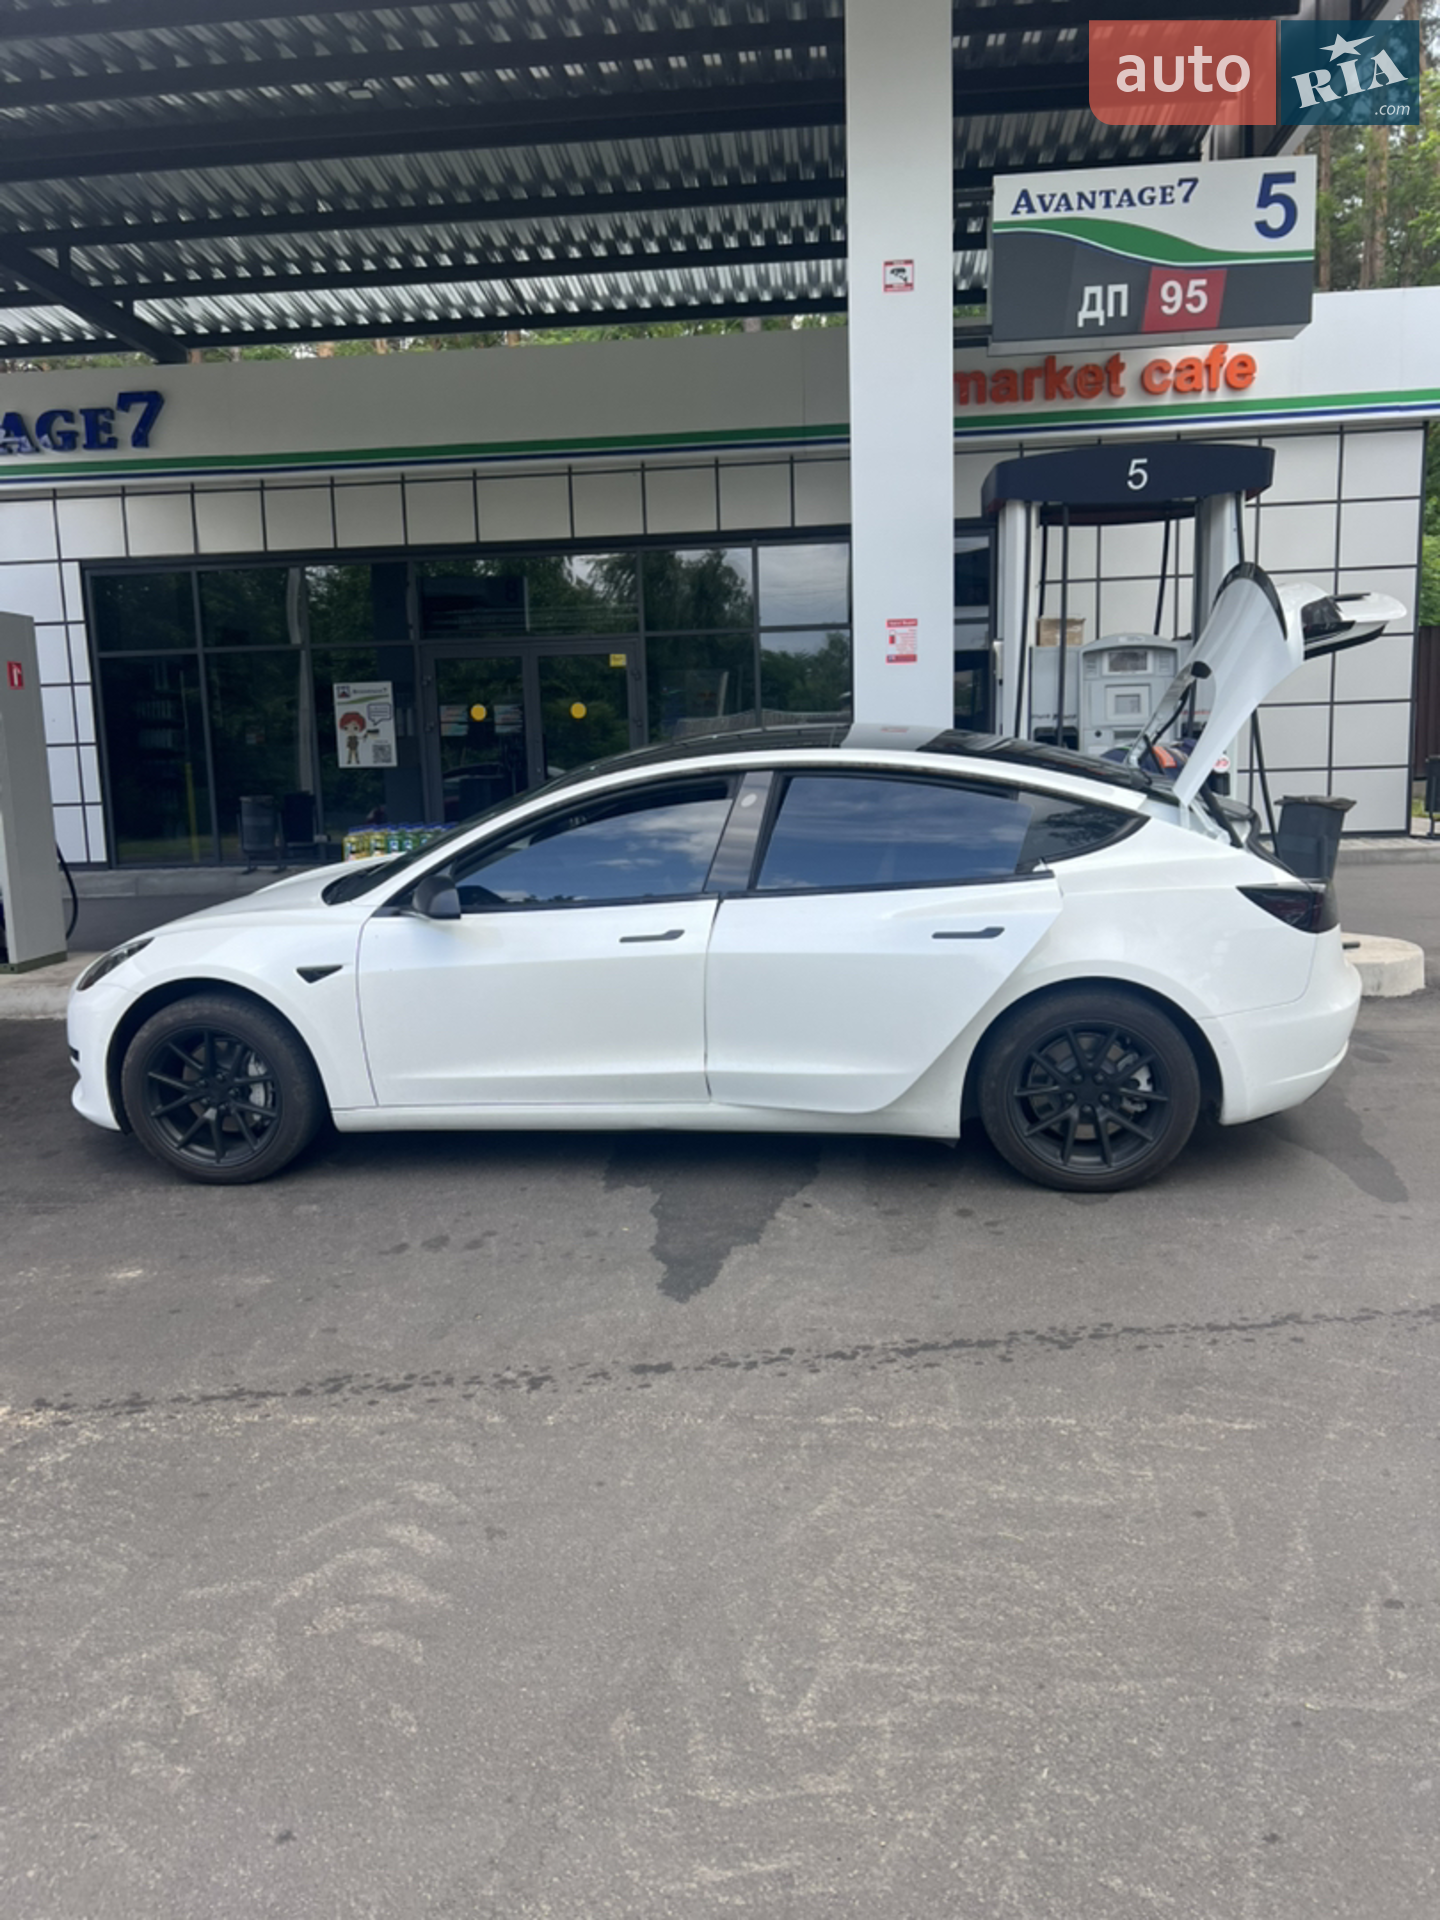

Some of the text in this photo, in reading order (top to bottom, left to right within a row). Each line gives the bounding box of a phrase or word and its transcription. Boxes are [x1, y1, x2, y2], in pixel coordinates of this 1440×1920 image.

[1254, 171, 1299, 239] 5
[1077, 278, 1209, 328] ДП 95
[953, 342, 1257, 405] market cafe
[1126, 457, 1149, 490] 5
